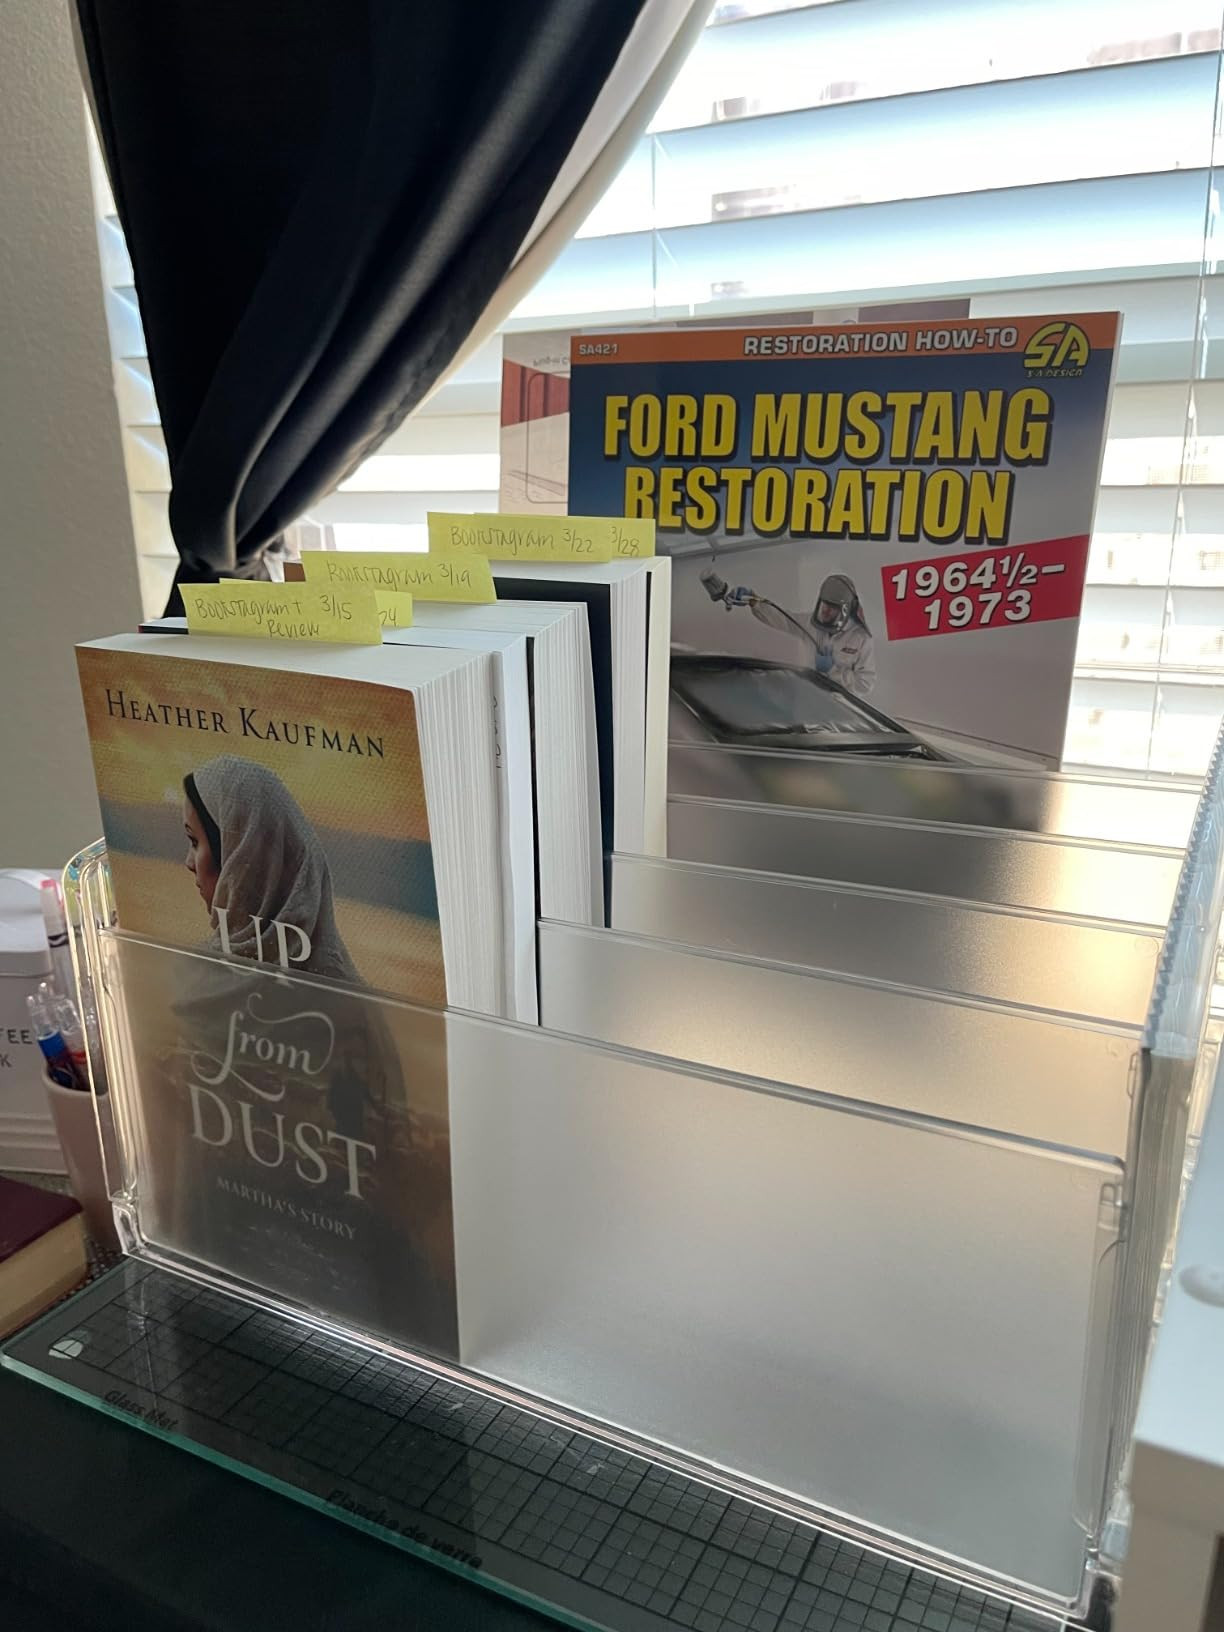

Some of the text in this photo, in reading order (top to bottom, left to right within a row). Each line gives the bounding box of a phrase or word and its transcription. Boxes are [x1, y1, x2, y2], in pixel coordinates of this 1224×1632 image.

[578, 343, 619, 356] SA421
[744, 327, 1018, 355] RESTORATION HOW-TO
[1024, 322, 1089, 368] SA
[603, 386, 1054, 465] FORD MUSTANG
[624, 464, 1015, 545] RESTORATION
[562, 528, 595, 554] 3/22
[605, 524, 640, 558] 3/28
[438, 561, 473, 589] 3/19
[319, 594, 352, 621] 3/15
[923, 588, 1033, 631] 1973
[266, 619, 320, 640] Review
[213, 905, 313, 986] UP
[190, 992, 336, 1102] from
[187, 1082, 378, 1200] DUST
[215, 1175, 357, 1241] MARTHA'S STORY
